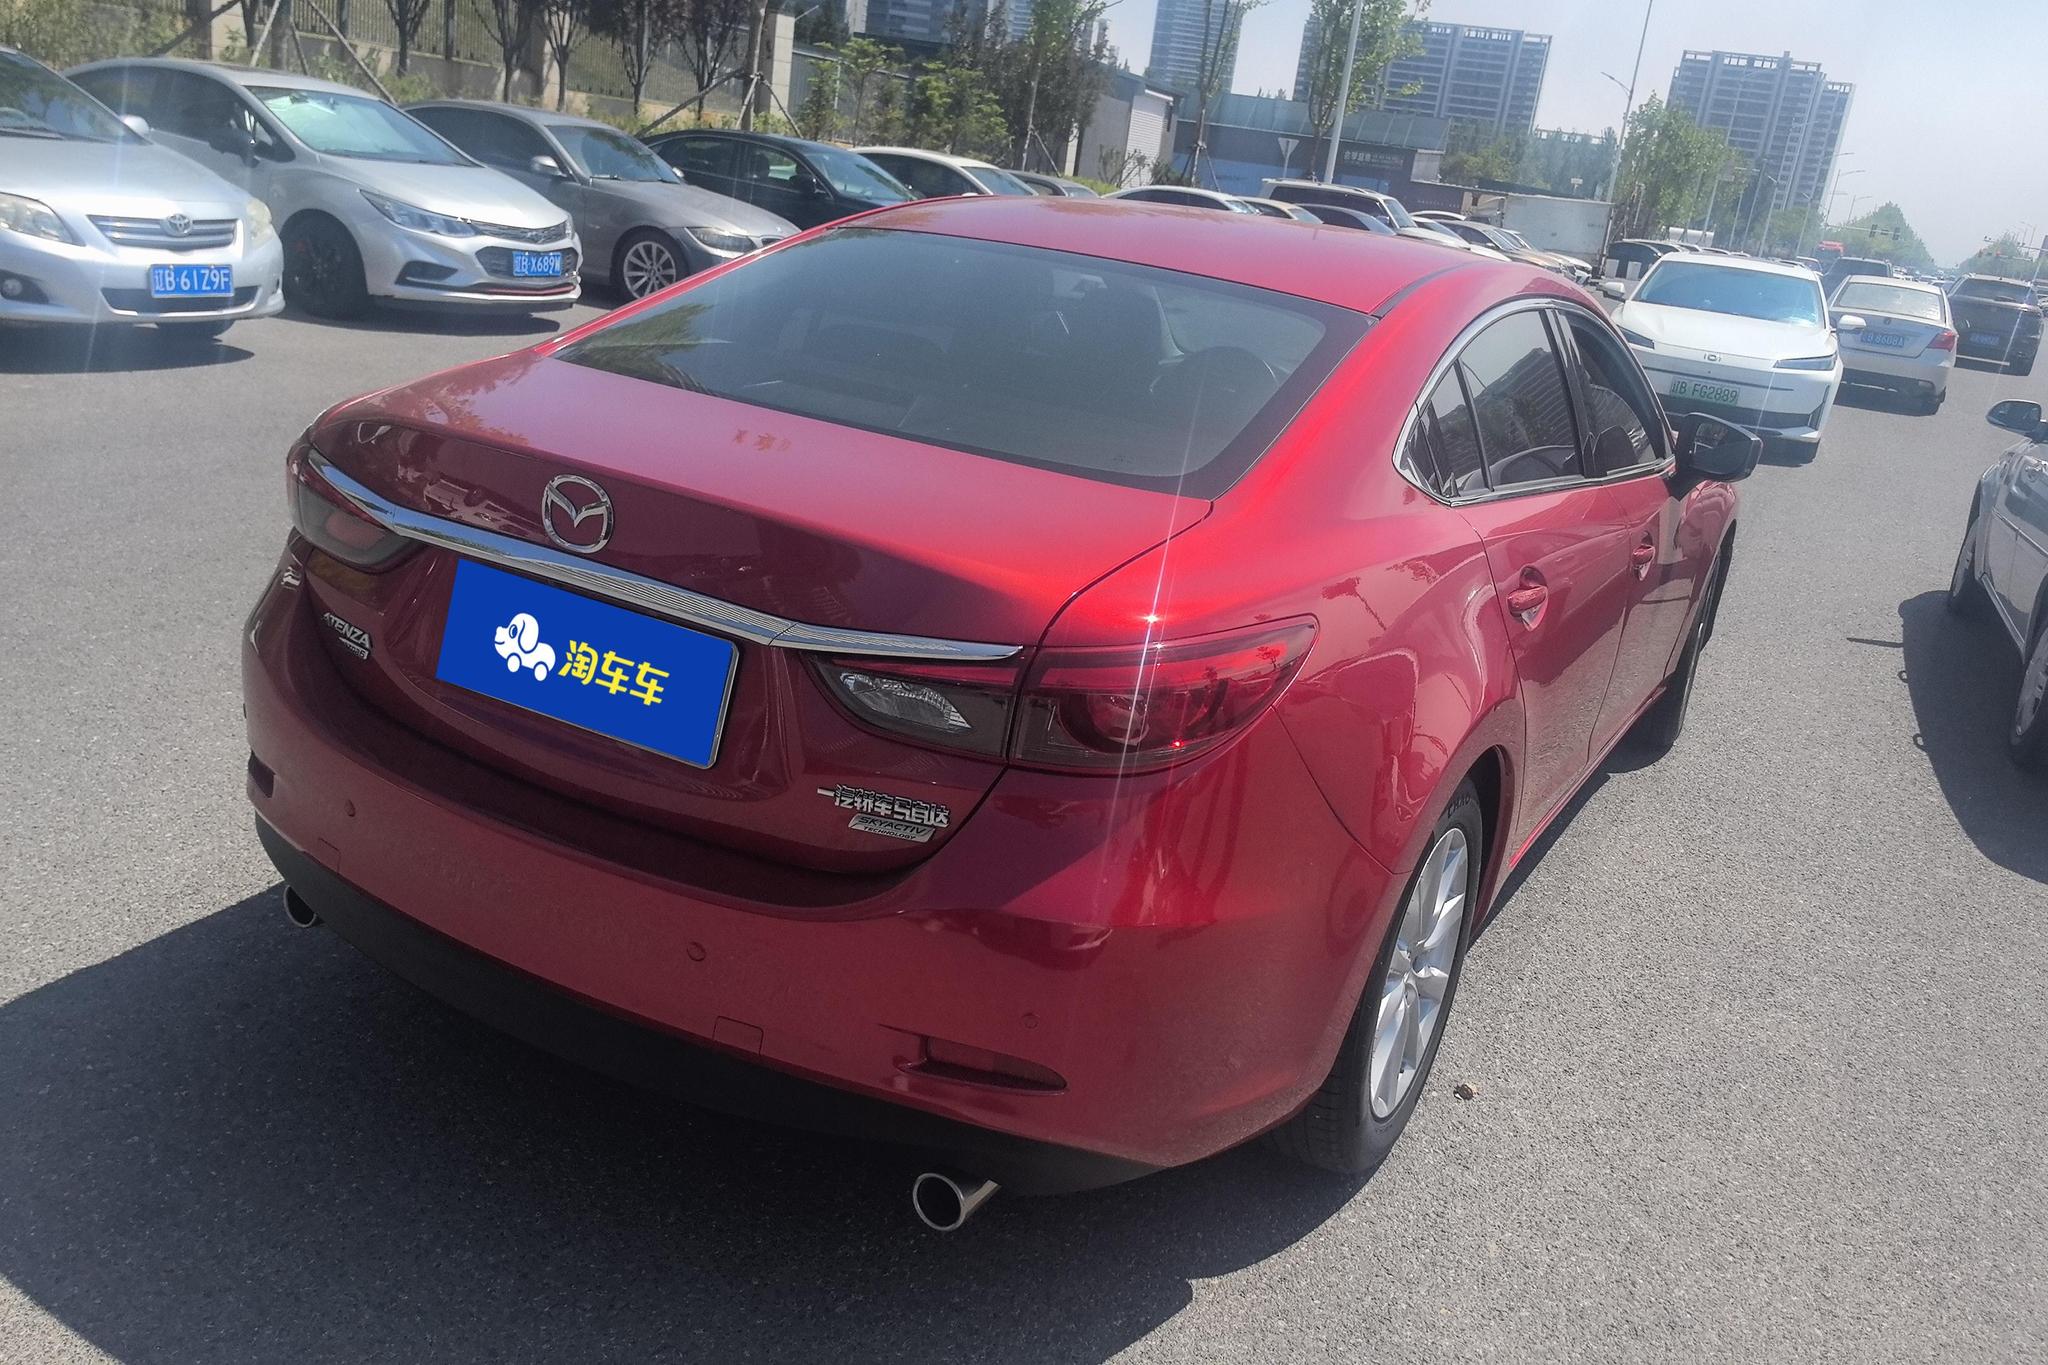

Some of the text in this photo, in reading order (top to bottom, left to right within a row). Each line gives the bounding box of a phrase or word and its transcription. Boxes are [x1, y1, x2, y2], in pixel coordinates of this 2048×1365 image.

[323, 612, 372, 650] ATENZA
[858, 815, 928, 835] SKYACTIV
[862, 825, 917, 841] TECHNOLOGY
